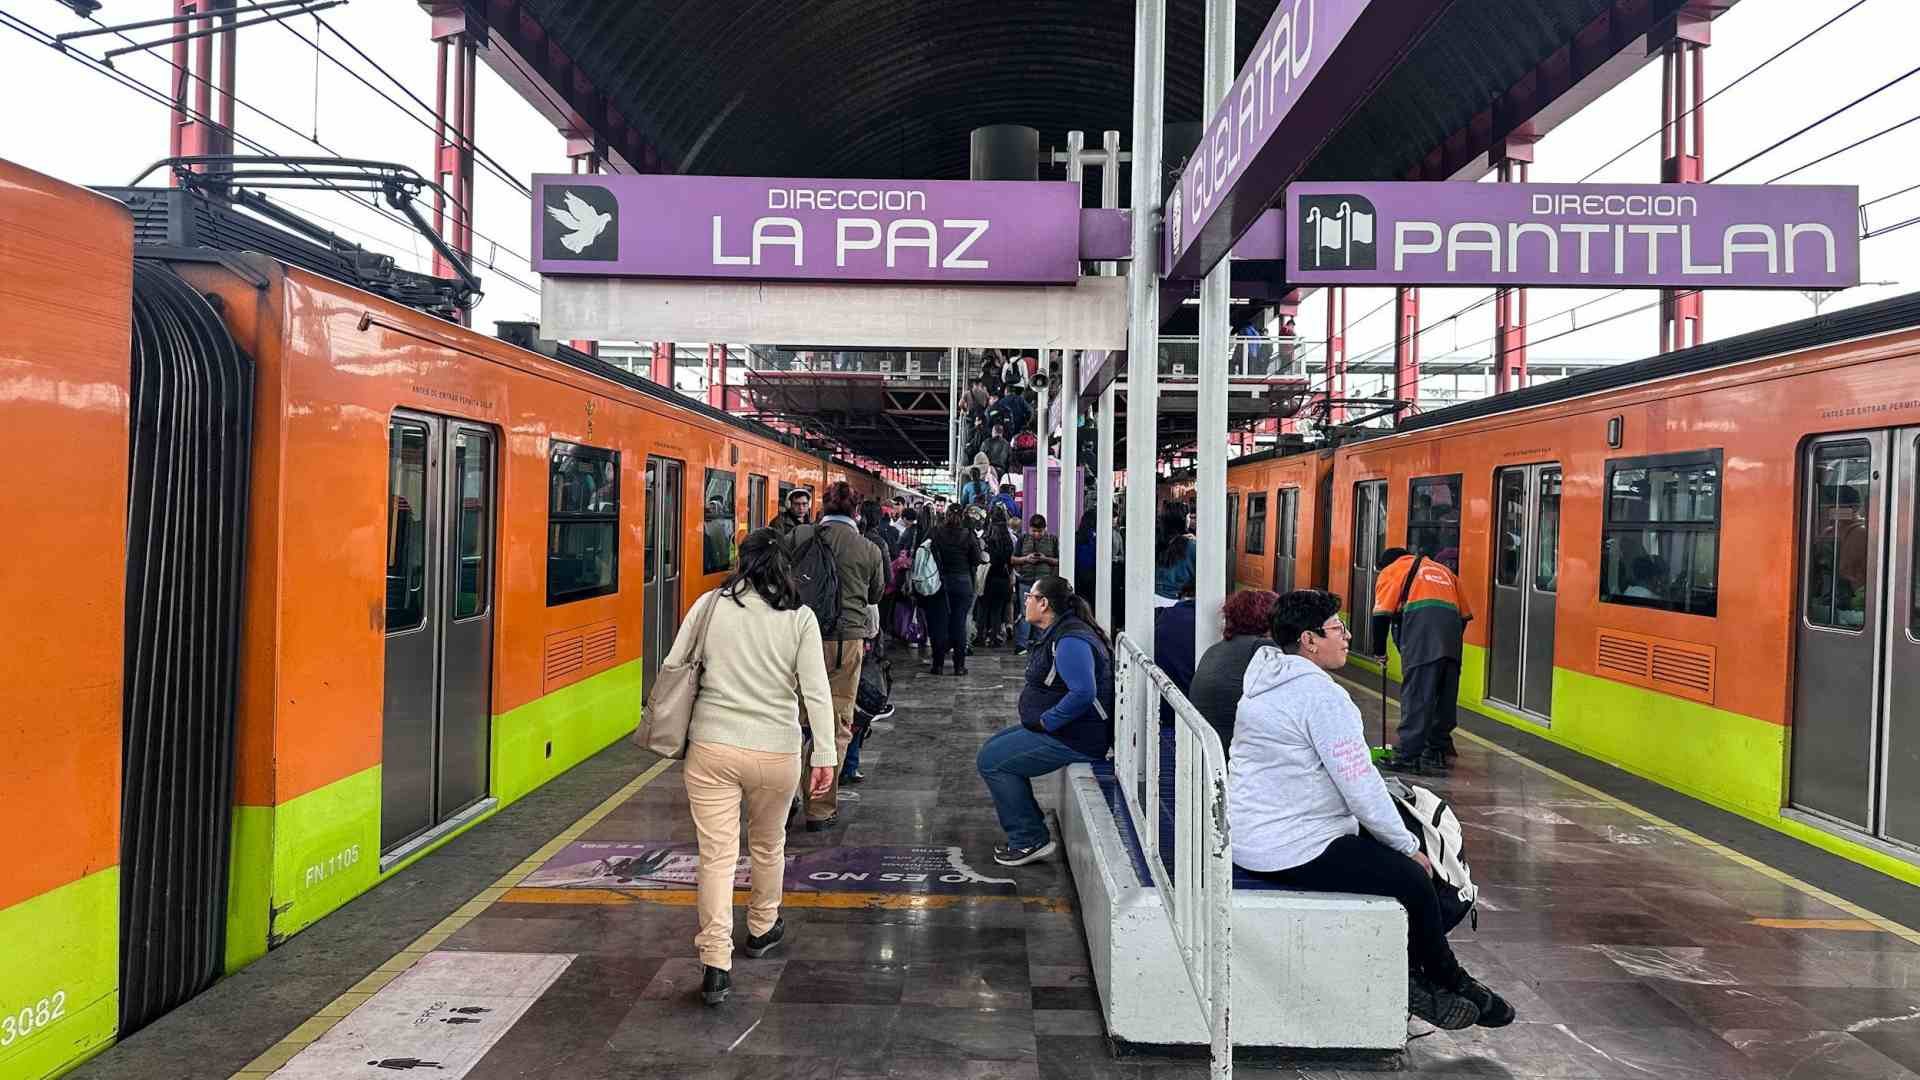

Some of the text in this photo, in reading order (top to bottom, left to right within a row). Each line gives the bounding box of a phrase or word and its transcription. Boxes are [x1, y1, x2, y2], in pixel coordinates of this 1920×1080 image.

[1192, 0, 1315, 225] GUELATAO
[768, 188, 926, 211] DIRECCION
[1531, 193, 1697, 217] DIRECCION
[712, 215, 990, 269] LA PAZ
[1393, 221, 1836, 275] PANTITLAN
[305, 844, 360, 889] FN.1105
[808, 871, 870, 882] NO
[880, 872, 929, 883] ES
[0, 990, 65, 1046] 3082
